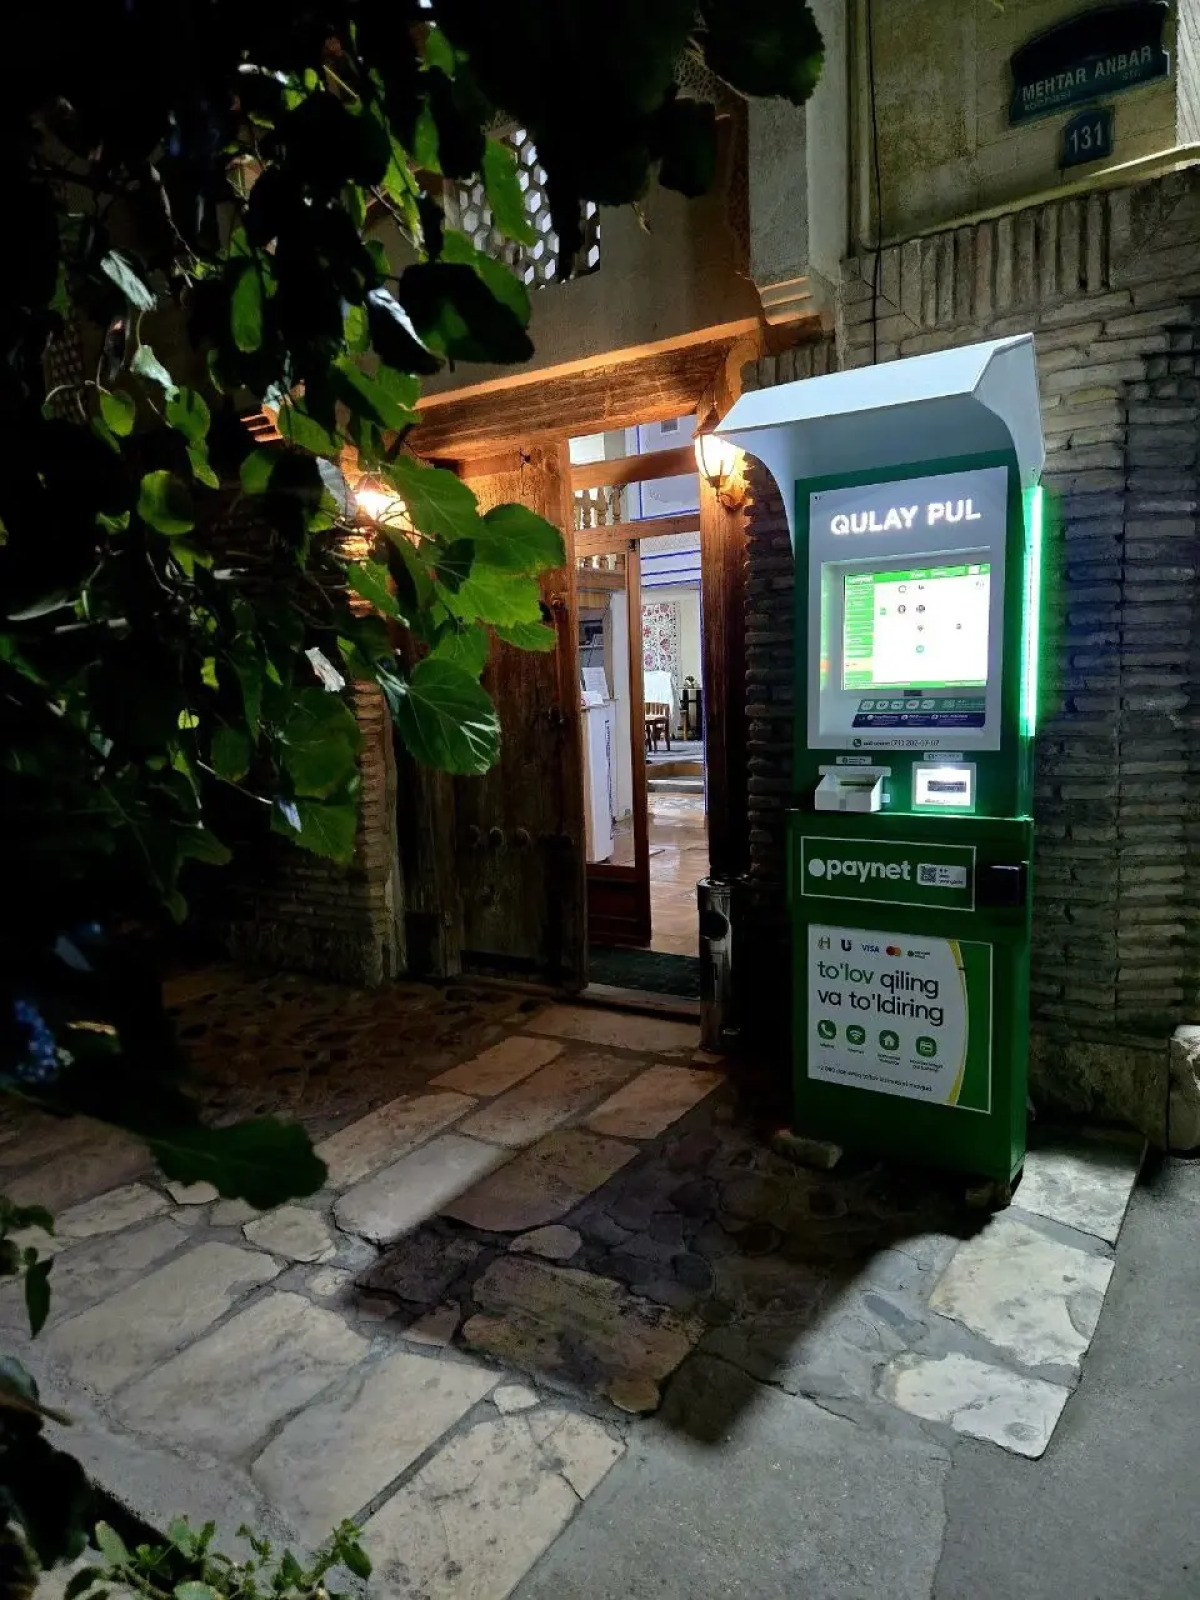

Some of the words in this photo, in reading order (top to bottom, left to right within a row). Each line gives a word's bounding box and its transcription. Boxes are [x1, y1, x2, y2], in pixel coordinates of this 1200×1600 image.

[1022, 67, 1086, 102] MEHTAR
[1094, 45, 1152, 78] ANBAR
[1070, 121, 1102, 153] 131
[830, 505, 919, 536] QULAY
[926, 498, 981, 526] PUL
[826, 858, 911, 883] paynet
[861, 944, 880, 953] VISA
[817, 960, 875, 985] to'lov
[880, 970, 939, 999] qiling
[817, 989, 842, 1006] va
[849, 992, 944, 1027] to'ldiring
